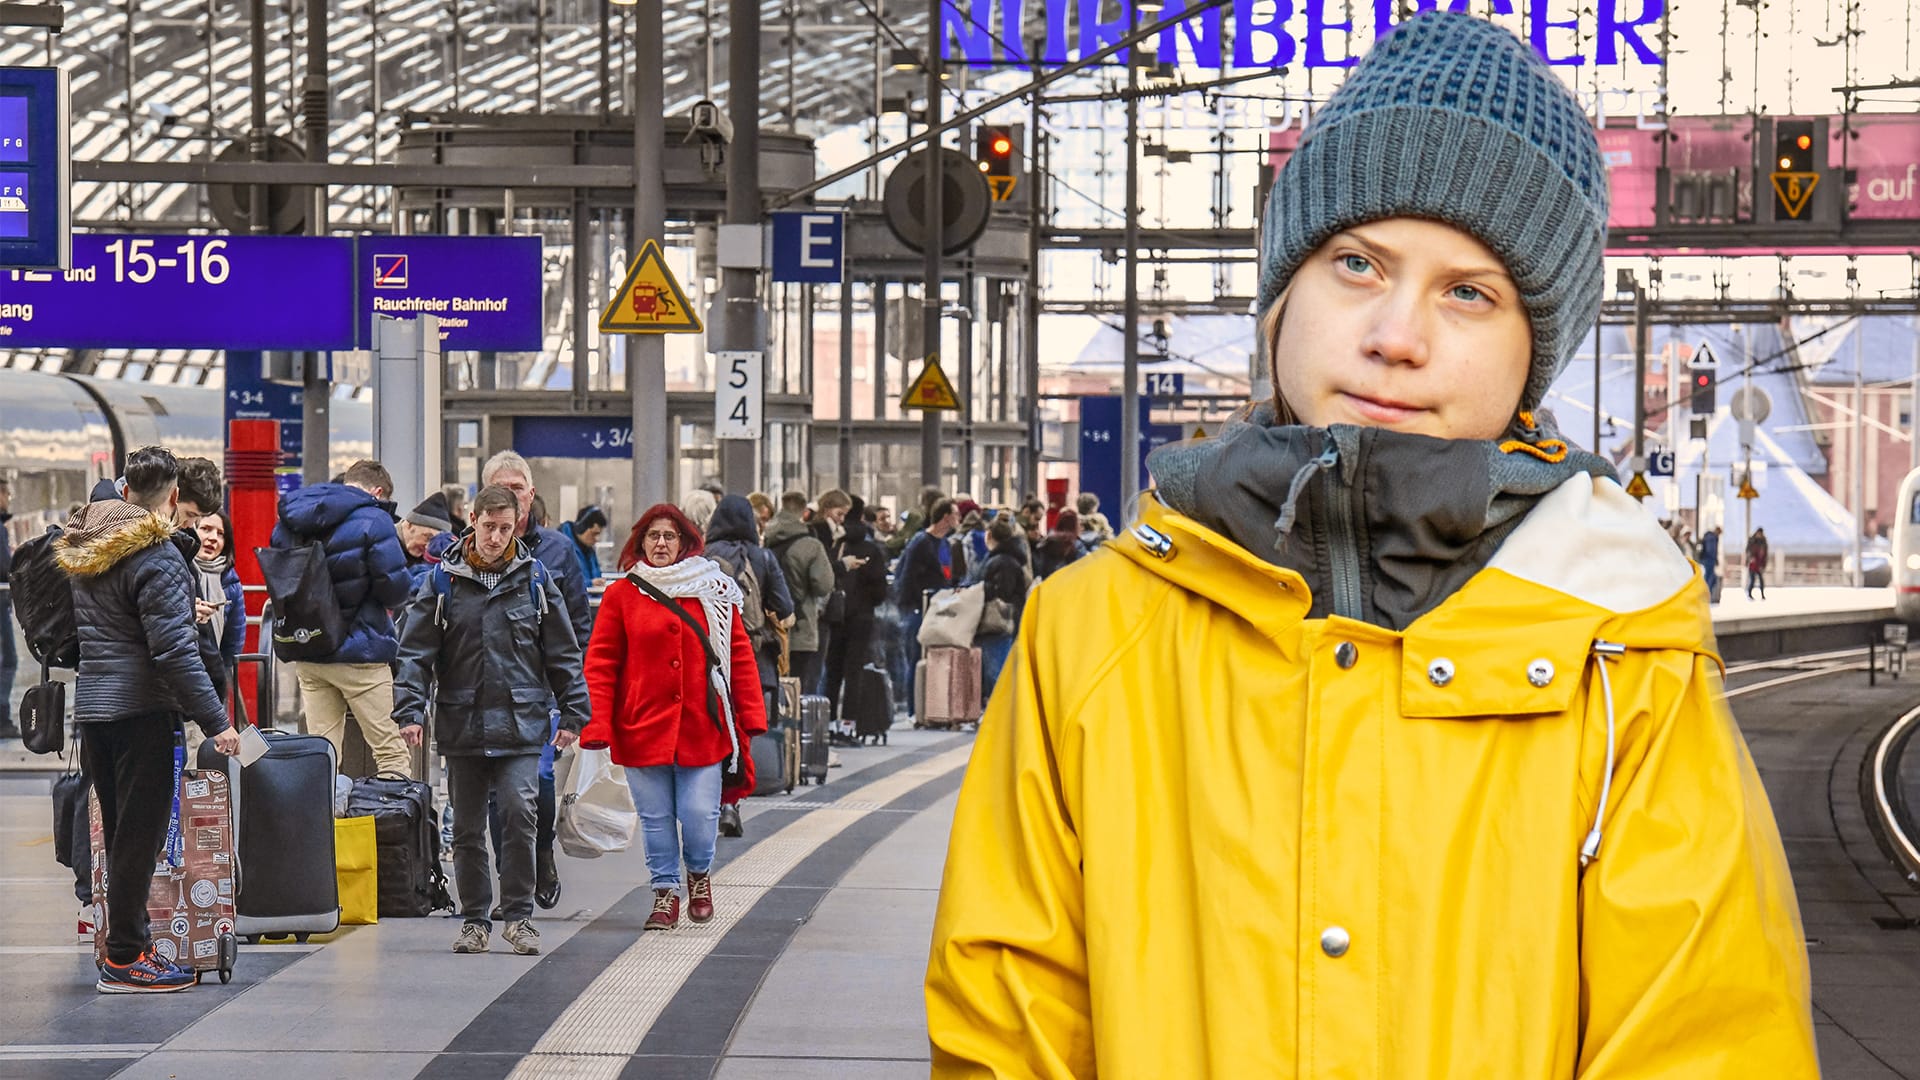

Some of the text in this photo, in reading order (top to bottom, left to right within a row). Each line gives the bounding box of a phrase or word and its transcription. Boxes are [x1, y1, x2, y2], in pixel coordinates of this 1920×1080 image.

[4, 138, 11, 148] F
[4, 186, 11, 196] F
[1867, 163, 1918, 202] auf
[801, 215, 834, 267] E
[64, 239, 230, 284] und 15-16
[373, 297, 508, 312] Rauchfreier Bahnhof
[729, 359, 748, 389] 5
[1150, 374, 1176, 396] 14
[729, 395, 749, 426] 4
[1657, 453, 1673, 473] G
